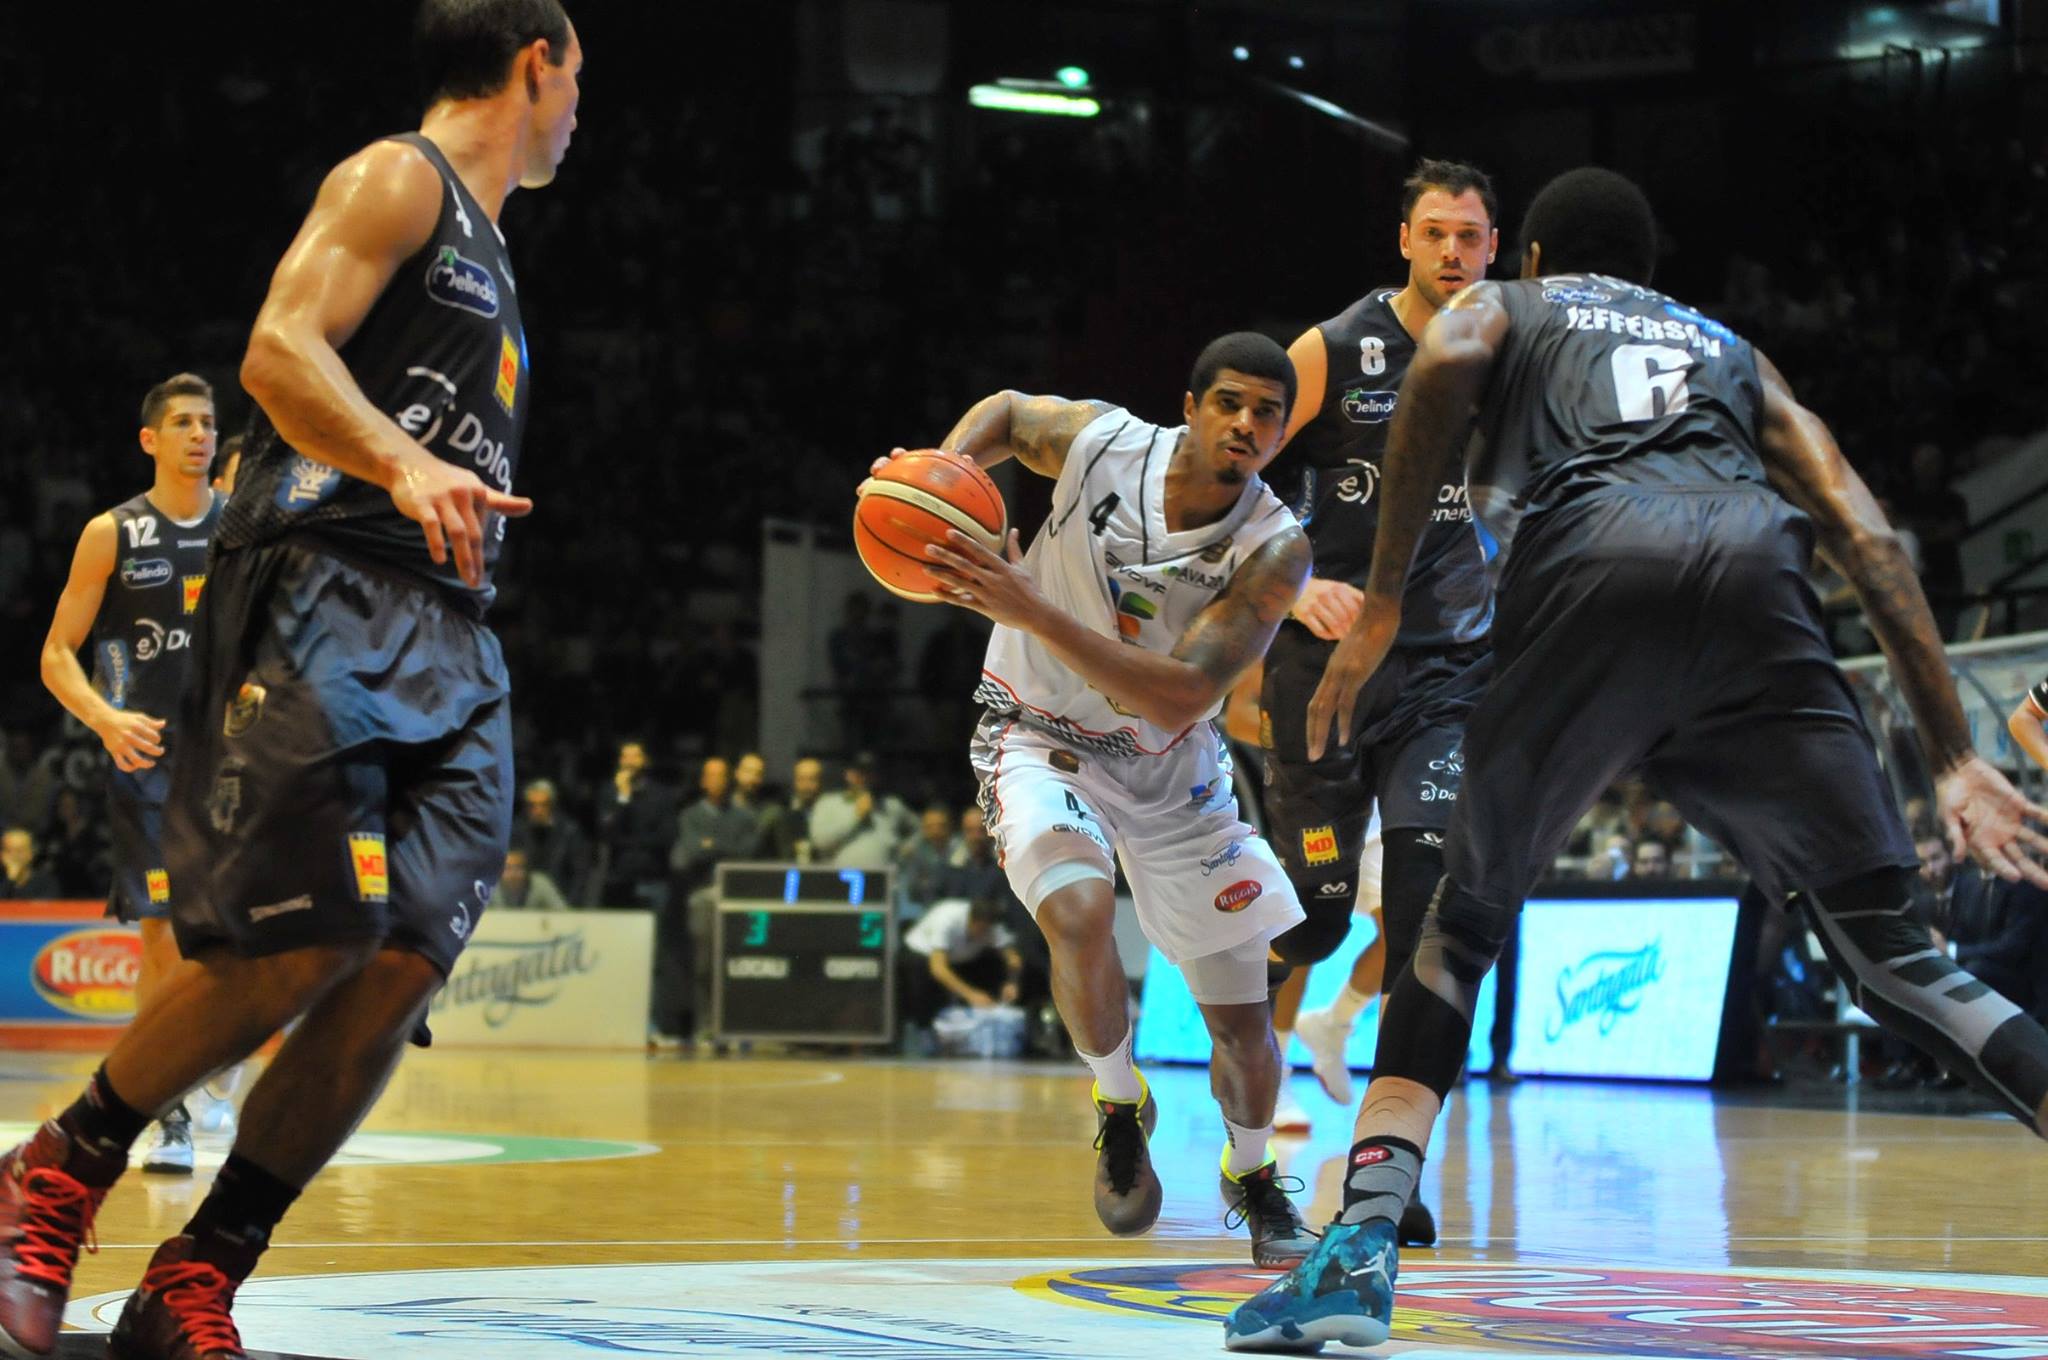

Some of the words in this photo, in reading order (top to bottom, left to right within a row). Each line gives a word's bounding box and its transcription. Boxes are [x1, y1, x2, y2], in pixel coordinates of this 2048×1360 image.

[1360, 337, 1386, 375] 8
[1611, 344, 1694, 422] 6
[1088, 491, 1121, 537] 4
[123, 516, 160, 548] 12
[1064, 789, 1087, 820] 4
[1306, 837, 1334, 854] MD
[1219, 883, 1258, 908] REGGIA
